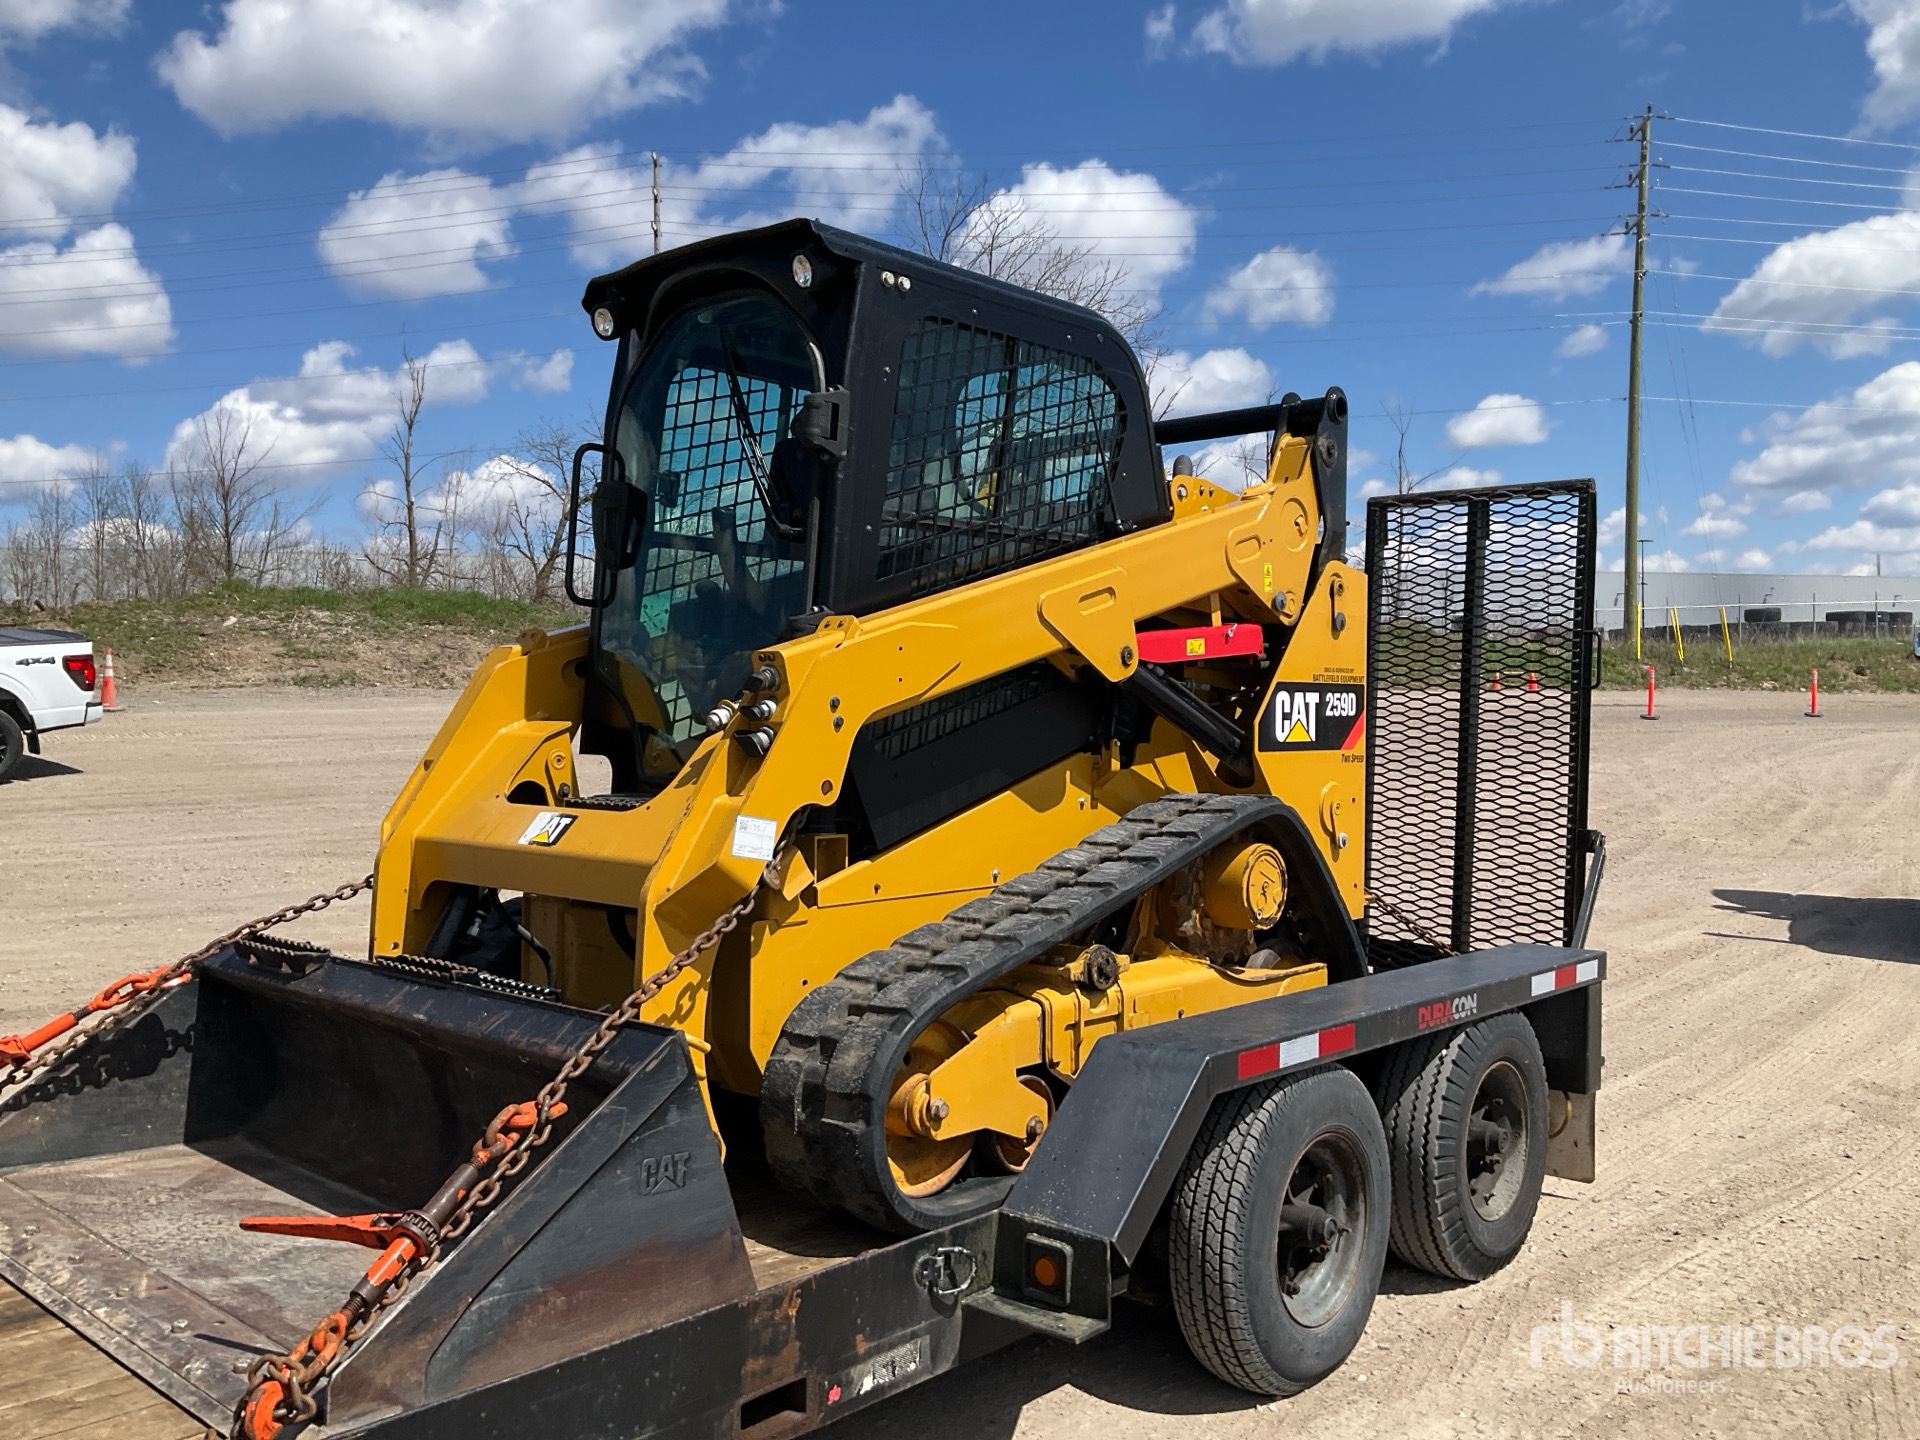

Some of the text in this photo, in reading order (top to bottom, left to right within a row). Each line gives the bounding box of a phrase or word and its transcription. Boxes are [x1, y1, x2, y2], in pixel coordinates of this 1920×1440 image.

[1340, 675, 1364, 683] EQUIPMENT
[1275, 690, 1356, 742] CAT 259D
[527, 815, 573, 844] AT
[1418, 993, 1477, 1029] DURACON
[640, 1152, 690, 1195] CAT
